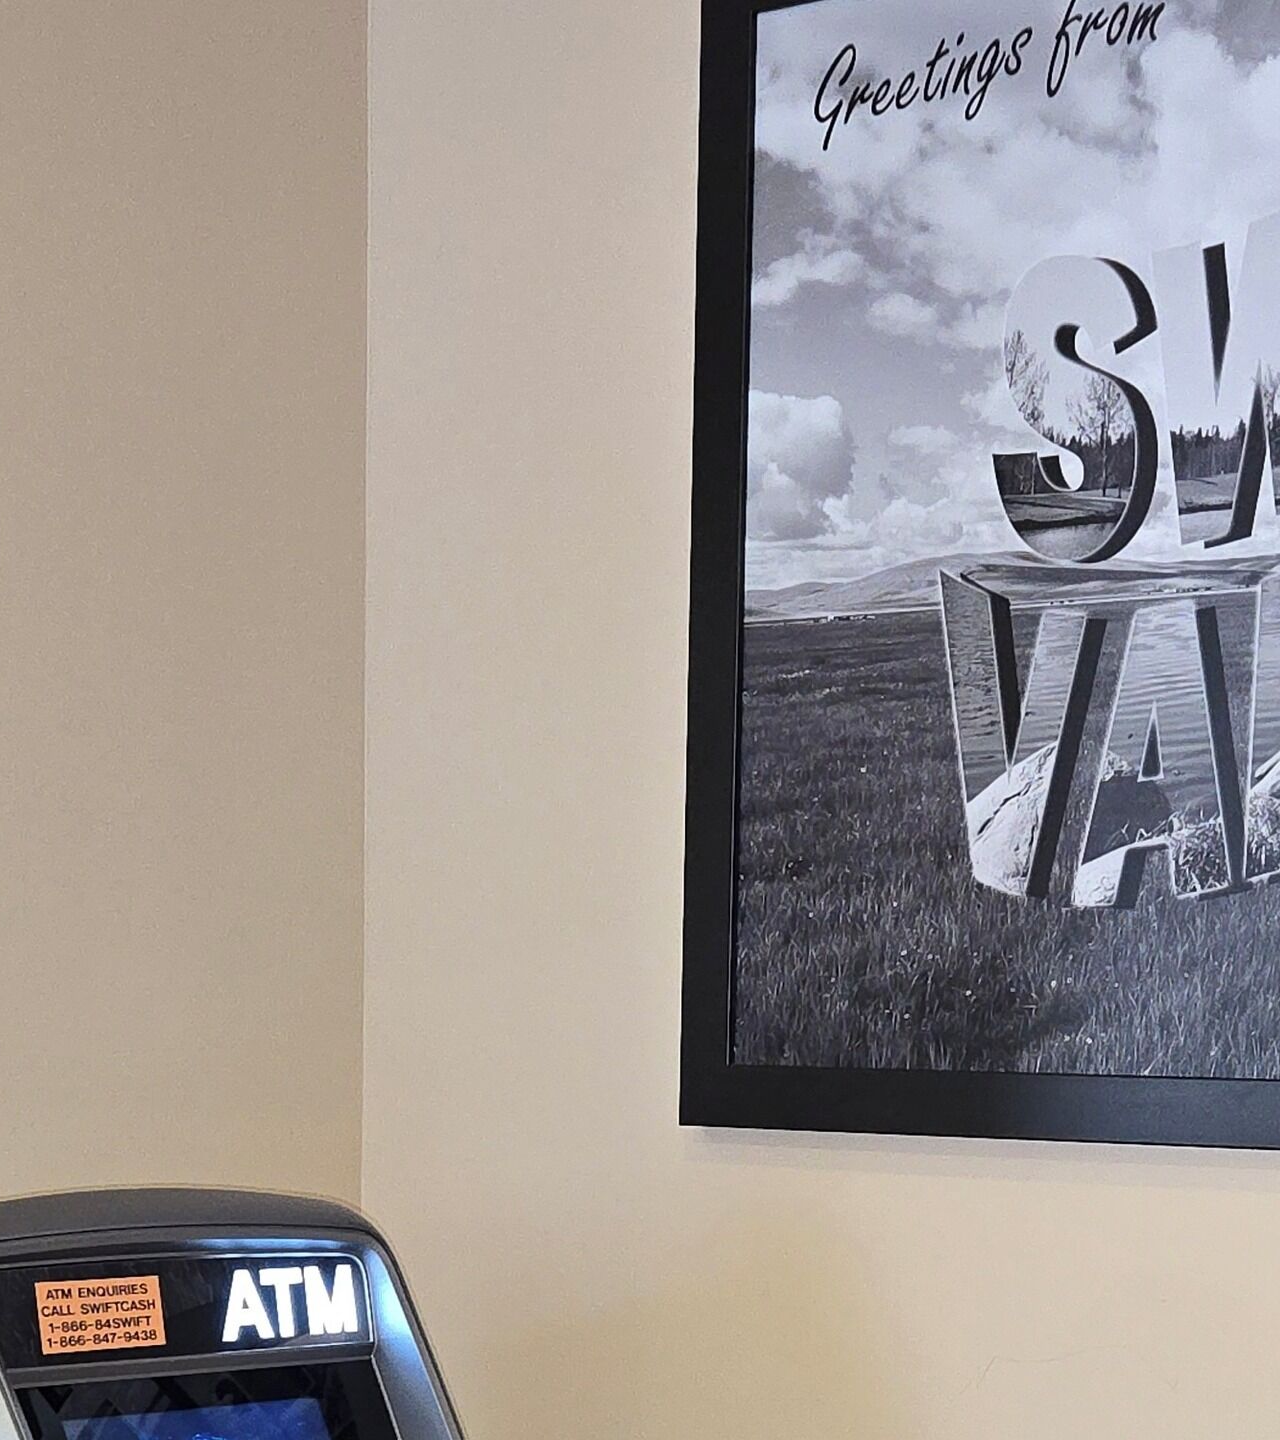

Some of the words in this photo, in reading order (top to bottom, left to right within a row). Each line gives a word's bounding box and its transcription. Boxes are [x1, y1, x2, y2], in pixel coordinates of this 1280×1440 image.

[814, 27, 1033, 150] Greetings
[1046, 0, 1165, 97] from
[46, 1288, 72, 1300] ATM
[78, 1283, 148, 1298] ENQUIRIES
[41, 1305, 75, 1317] CALL
[80, 1299, 156, 1315] SWIFTCASH
[222, 1264, 358, 1342] ATM
[48, 1316, 152, 1334] 1-866-84SWIFT
[47, 1329, 157, 1348] 1-866-847-9438
